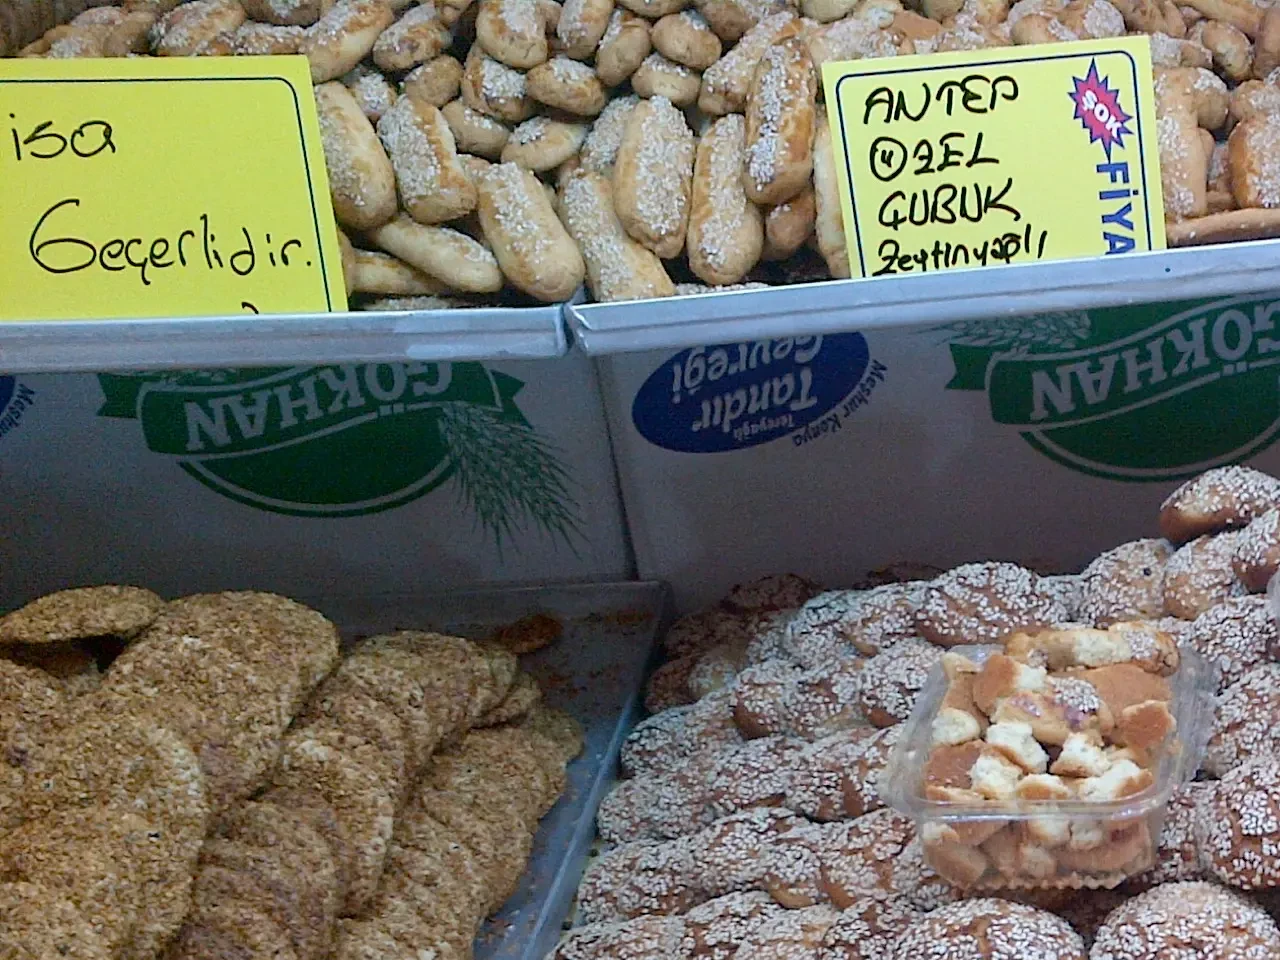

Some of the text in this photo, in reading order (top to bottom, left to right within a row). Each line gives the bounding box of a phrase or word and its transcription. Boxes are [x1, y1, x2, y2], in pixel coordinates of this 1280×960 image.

[863, 75, 1019, 124] ANTEP
[184, 362, 452, 450] GÖKHAN
[691, 366, 818, 434] Tandır
